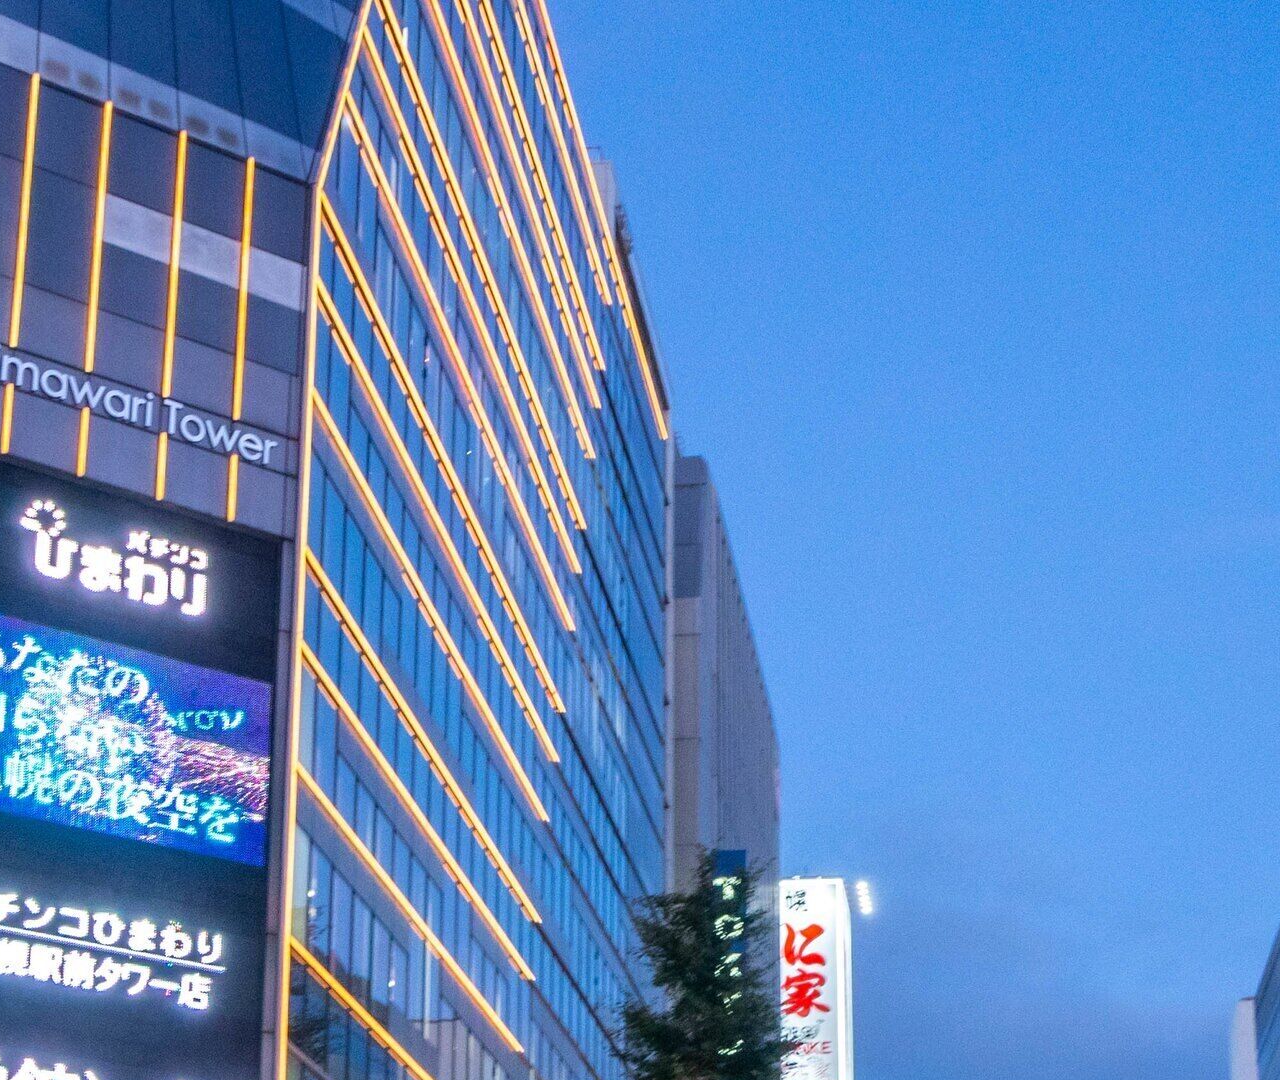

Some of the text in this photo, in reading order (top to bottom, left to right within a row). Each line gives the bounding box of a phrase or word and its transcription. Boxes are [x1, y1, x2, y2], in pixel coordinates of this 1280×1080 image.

[163, 399, 278, 465] Tower
[29, 520, 208, 616] ひまわり
